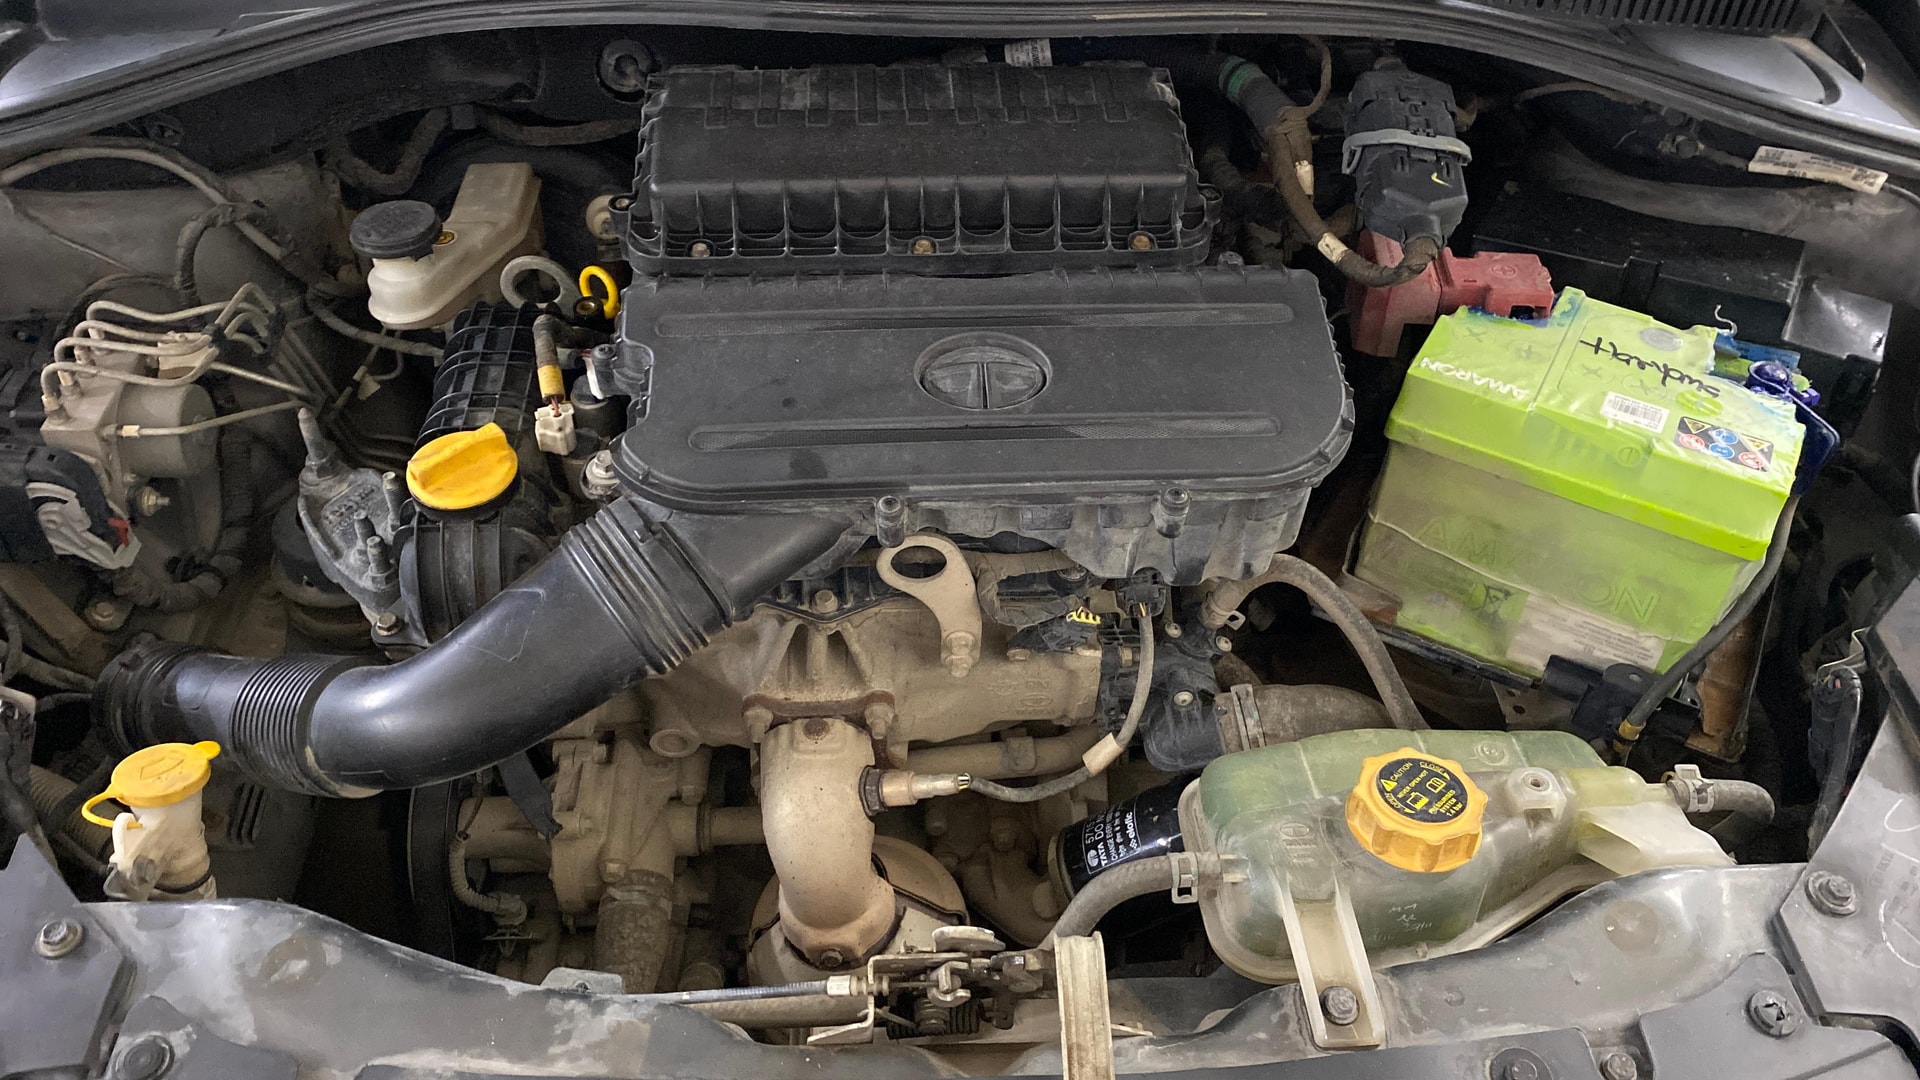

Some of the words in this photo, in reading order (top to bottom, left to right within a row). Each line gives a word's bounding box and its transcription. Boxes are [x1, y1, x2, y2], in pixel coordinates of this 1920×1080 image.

[1419, 357, 1530, 400] AMARON
[1390, 762, 1413, 781] CAUTION
[1420, 761, 1445, 774] CLOSE
[1397, 785, 1412, 798] NEVER
[1439, 797, 1457, 813] SYSTEM
[1125, 811, 1136, 839] elofic
[1097, 841, 1108, 867] TATA
[1106, 838, 1119, 861] CHANGE
